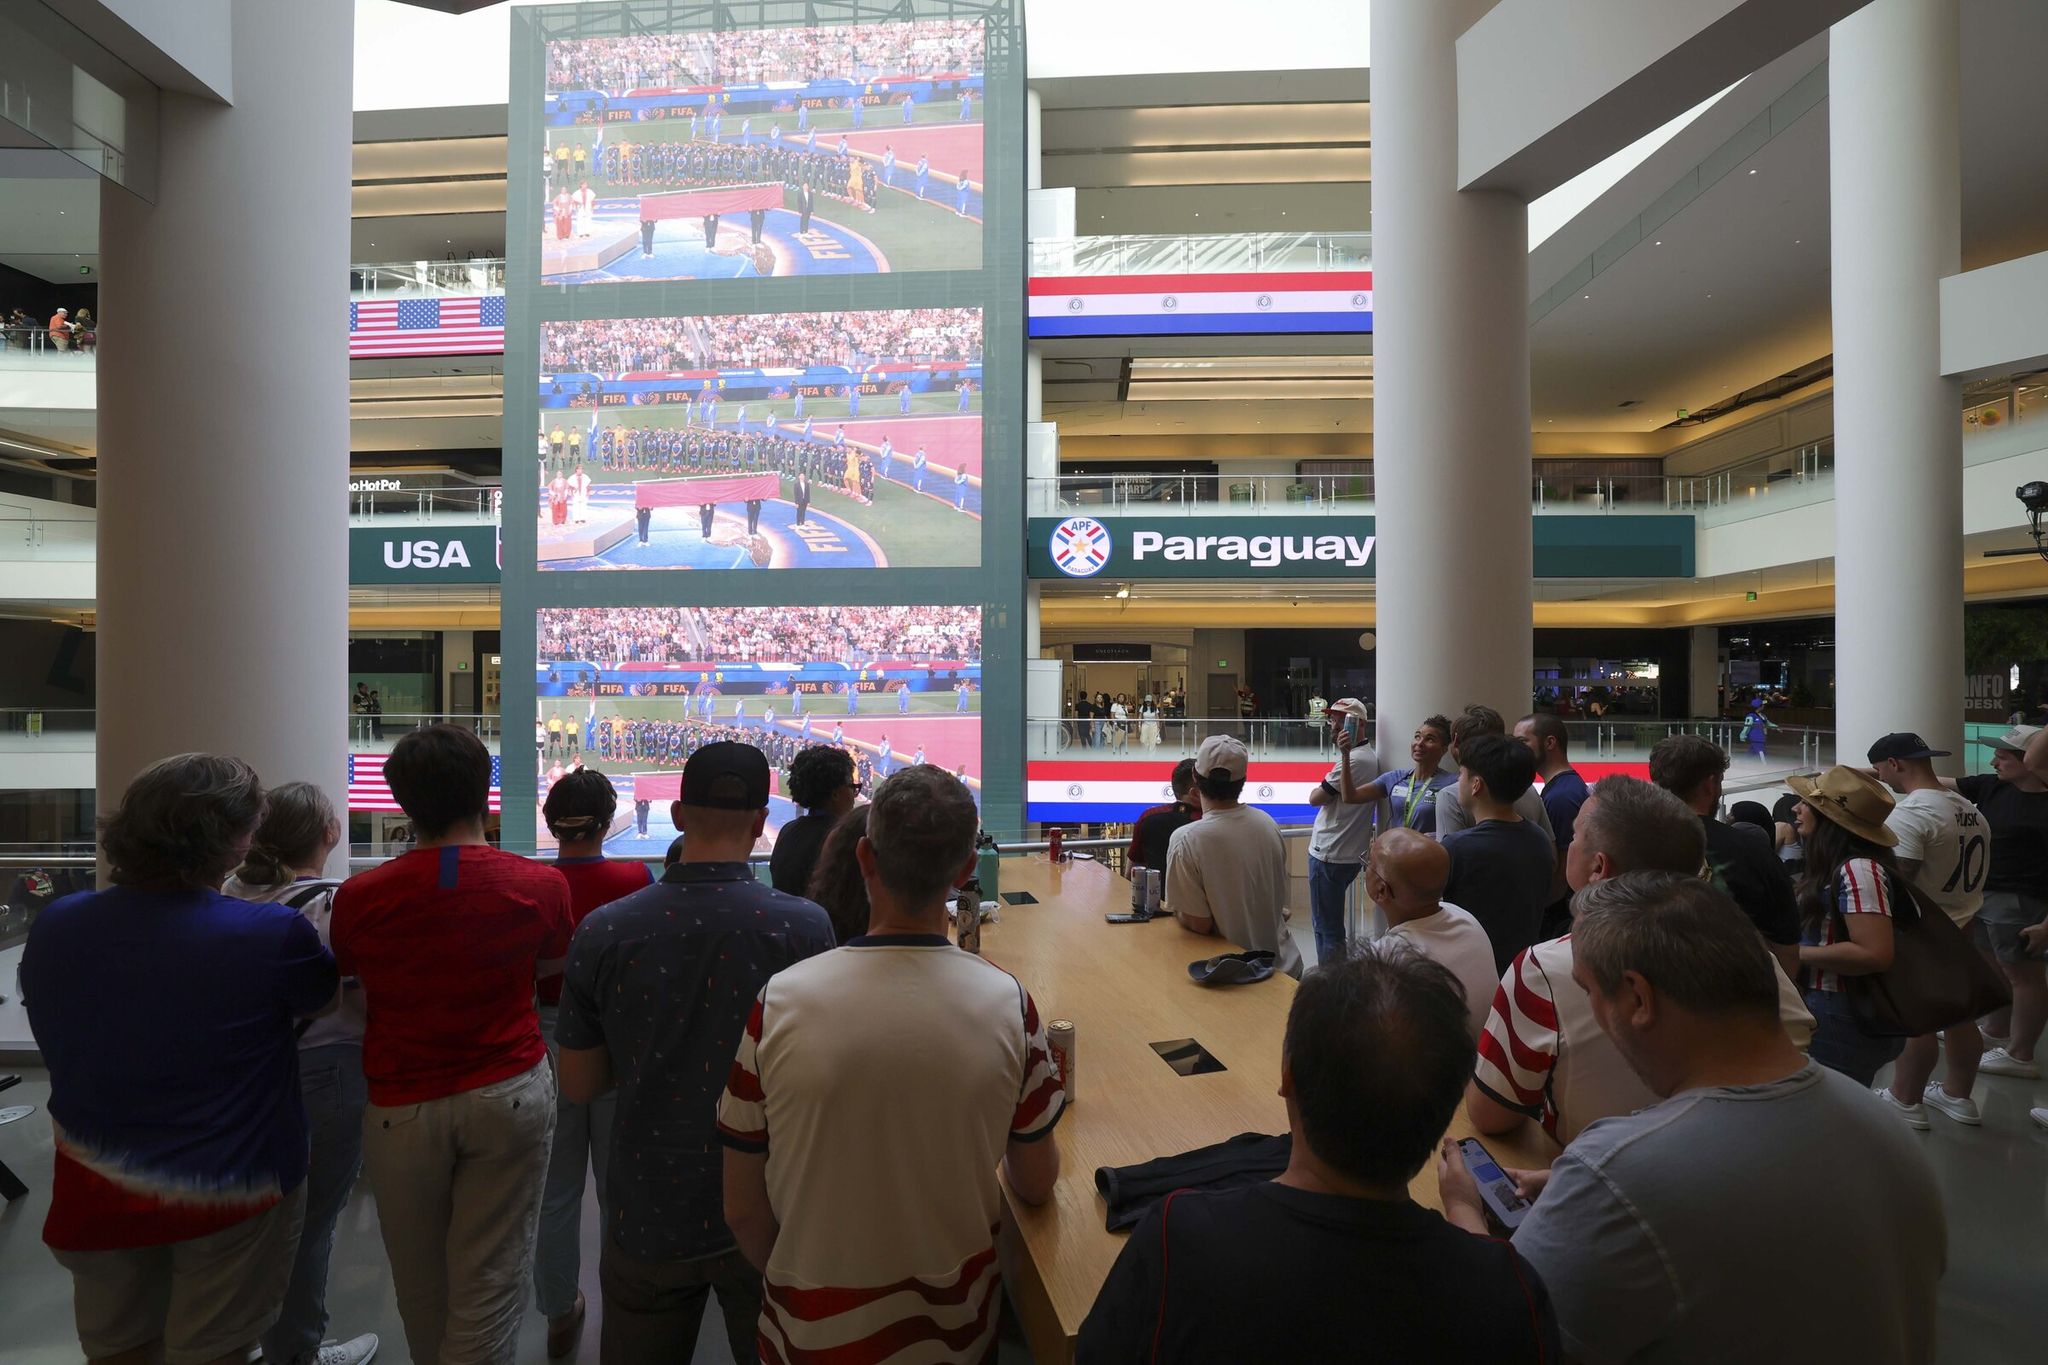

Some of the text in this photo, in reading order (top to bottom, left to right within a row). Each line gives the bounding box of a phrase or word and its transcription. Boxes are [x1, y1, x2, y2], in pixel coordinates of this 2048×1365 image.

[802, 99, 823, 108] FIFA
[860, 96, 881, 105] FIFA
[671, 107, 694, 116] FIFA
[608, 112, 631, 121] FIFA
[798, 387, 819, 396] FIFA
[857, 385, 878, 394] FIFA
[603, 395, 626, 404] FIFA
[666, 392, 689, 401] FIFA
[1071, 521, 1092, 531] APF
[1133, 531, 1376, 567] Paraguay
[384, 540, 471, 569] USA
[600, 685, 624, 694] FIFA
[663, 685, 688, 694] FIFA
[796, 683, 818, 692] FIFA
[855, 682, 877, 691] FIFA
[1965, 675, 2004, 697] INFO
[1965, 699, 2004, 709] DESK
[1942, 834, 1985, 893] 10
